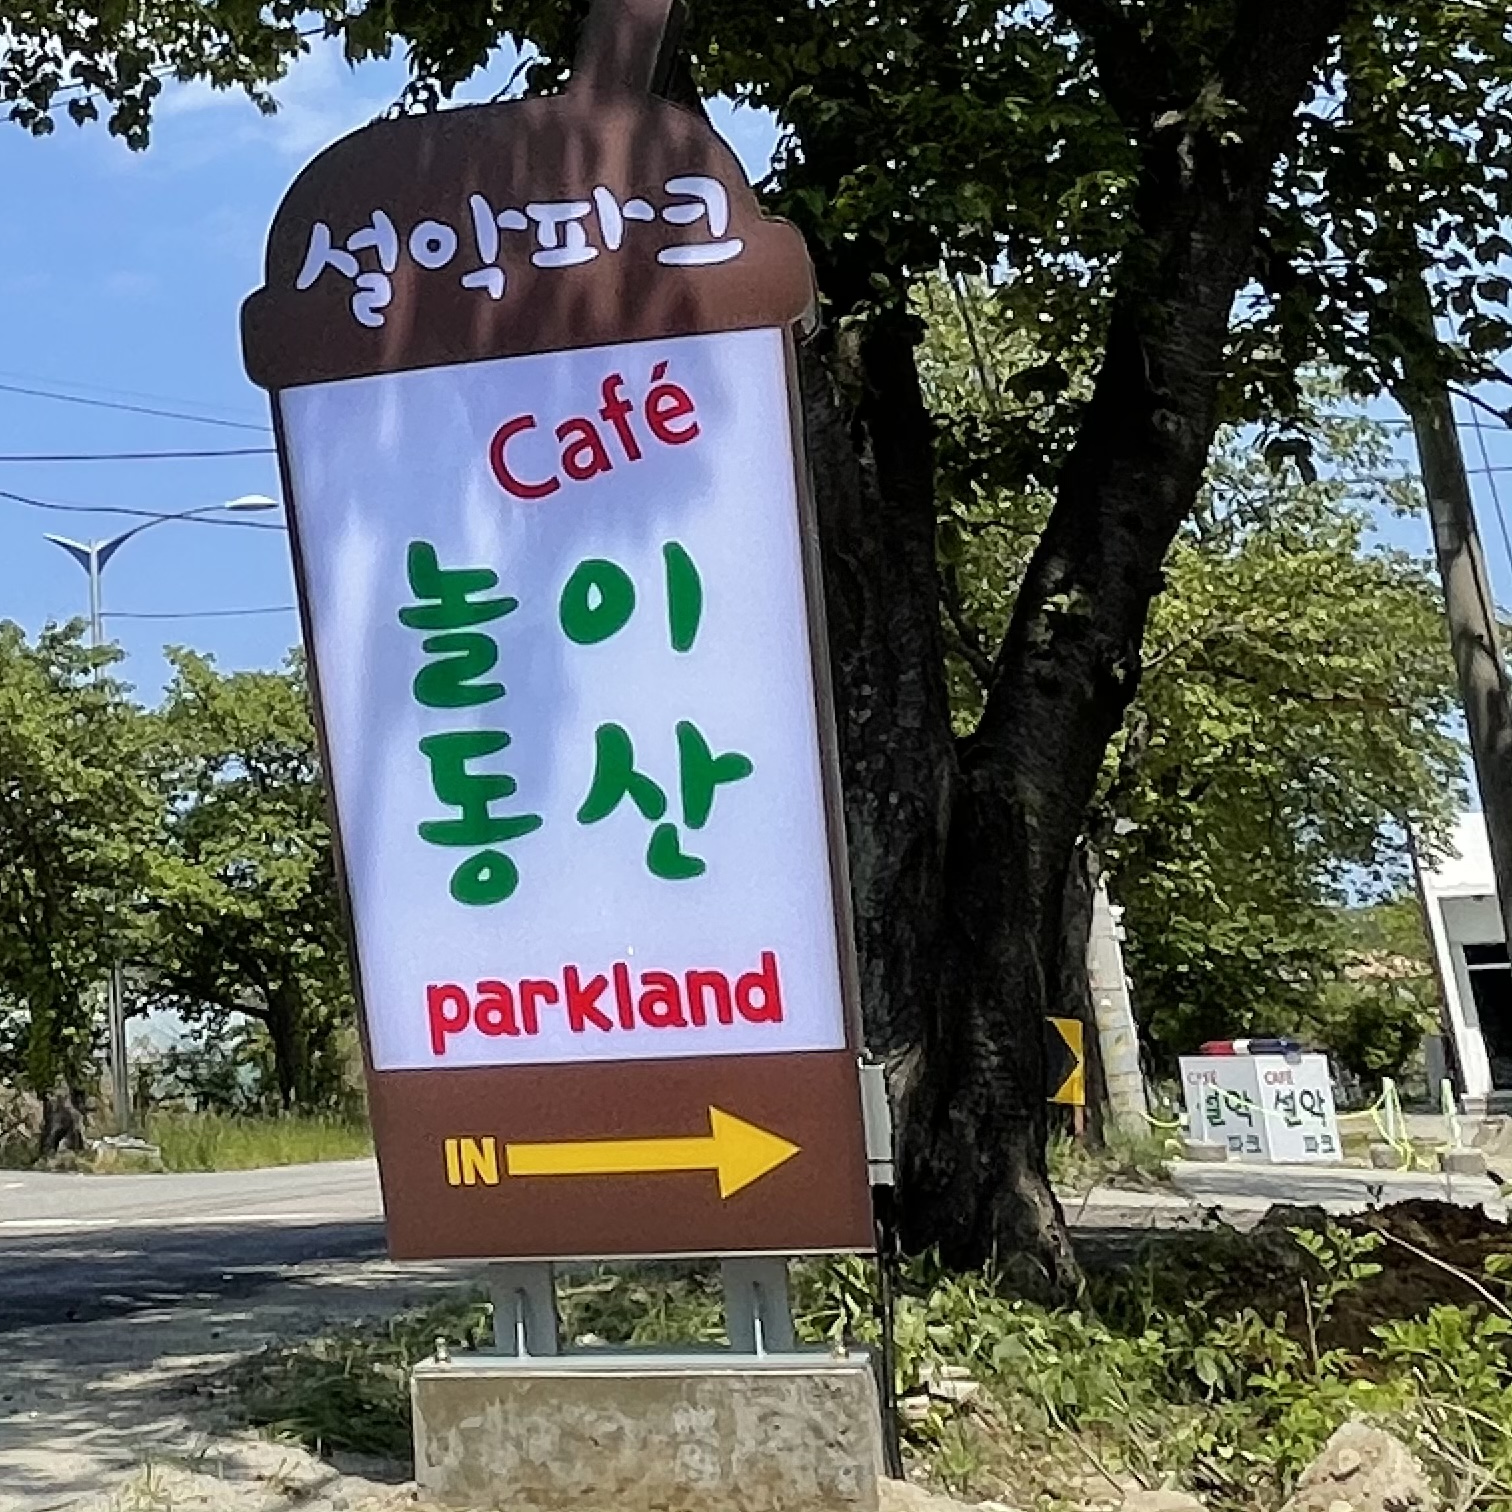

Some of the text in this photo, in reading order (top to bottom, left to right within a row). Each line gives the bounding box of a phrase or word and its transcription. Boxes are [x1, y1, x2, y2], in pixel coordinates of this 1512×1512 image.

[296, 175, 745, 327] 설악파크
[491, 361, 701, 500] Café
[398, 541, 704, 708] 놀이
[418, 720, 753, 905] 동산
[426, 952, 784, 1054] parkland
[444, 1137, 500, 1186] IN
[1274, 1089, 1326, 1128] 설악
